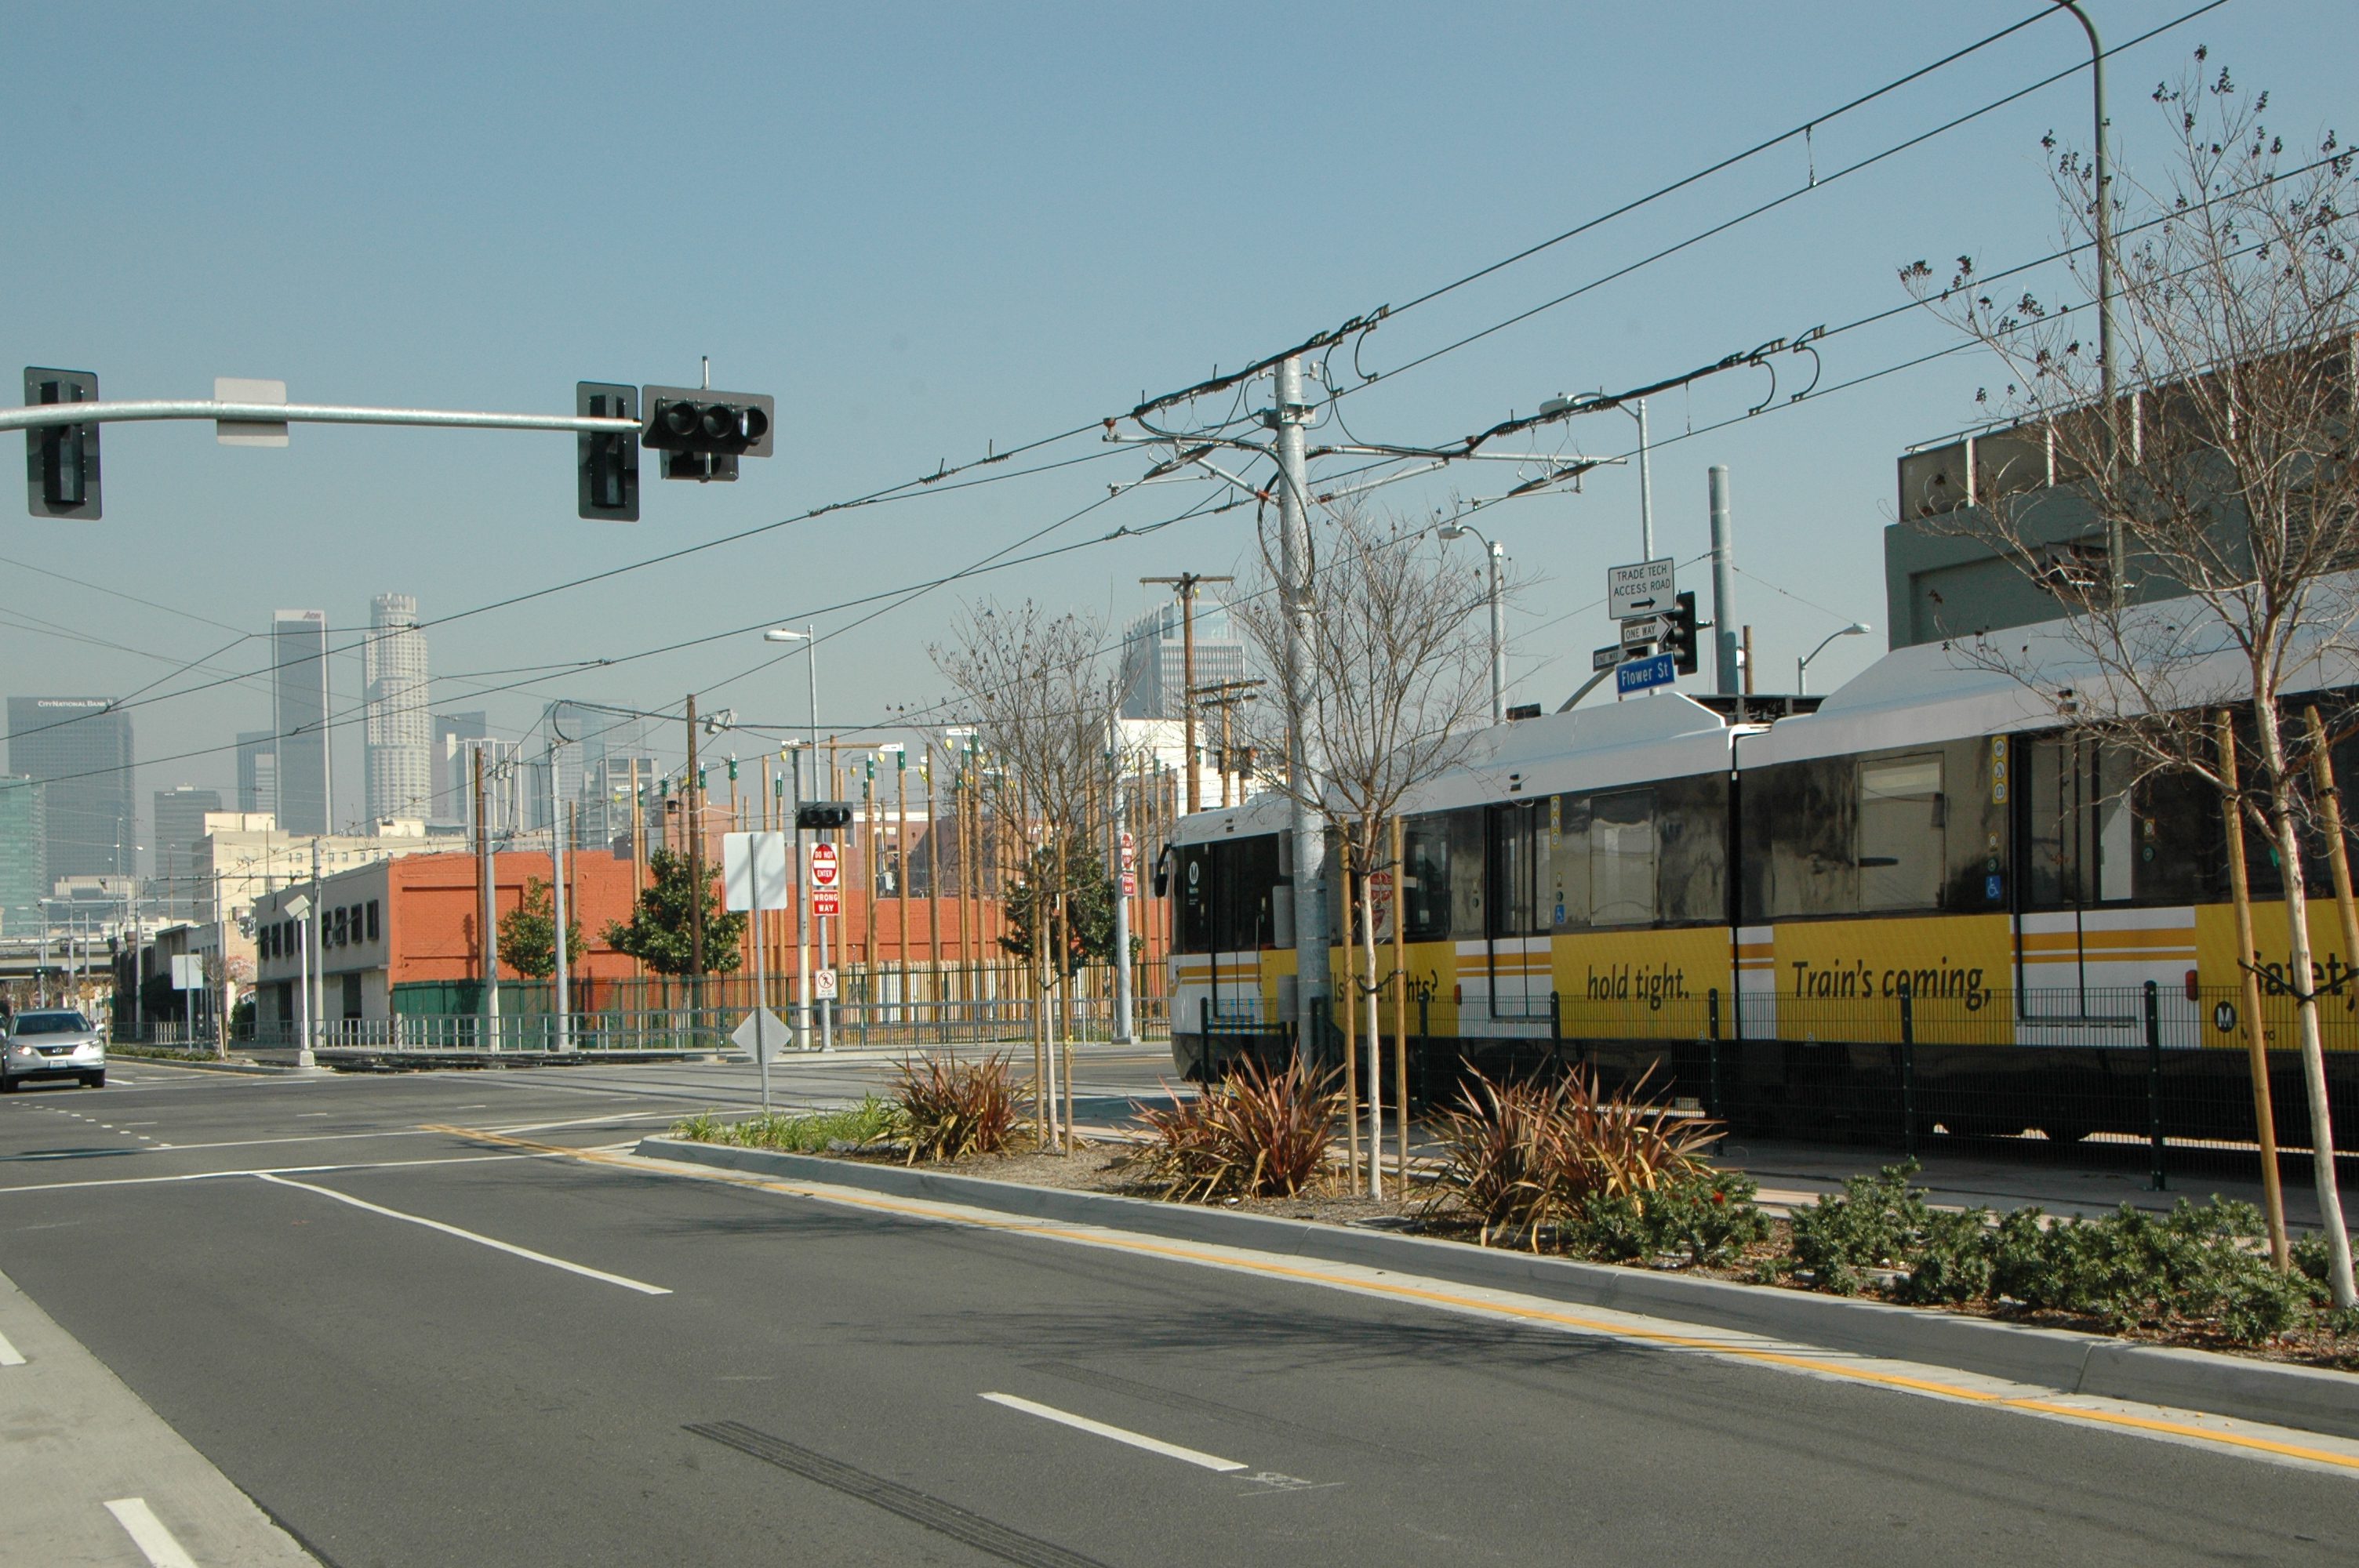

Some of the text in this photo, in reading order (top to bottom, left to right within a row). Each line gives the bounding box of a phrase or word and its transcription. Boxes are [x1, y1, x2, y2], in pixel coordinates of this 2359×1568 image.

[1617, 564, 1667, 582] TRADE TECH
[1614, 579, 1670, 597] ACCESS ROAD
[1626, 625, 1656, 640] ONE WAY
[1621, 662, 1669, 687] Flower St
[814, 893, 838, 902] WRONG
[1587, 961, 1690, 1011] hold tight.
[1791, 955, 1992, 1012] Train's coming,
